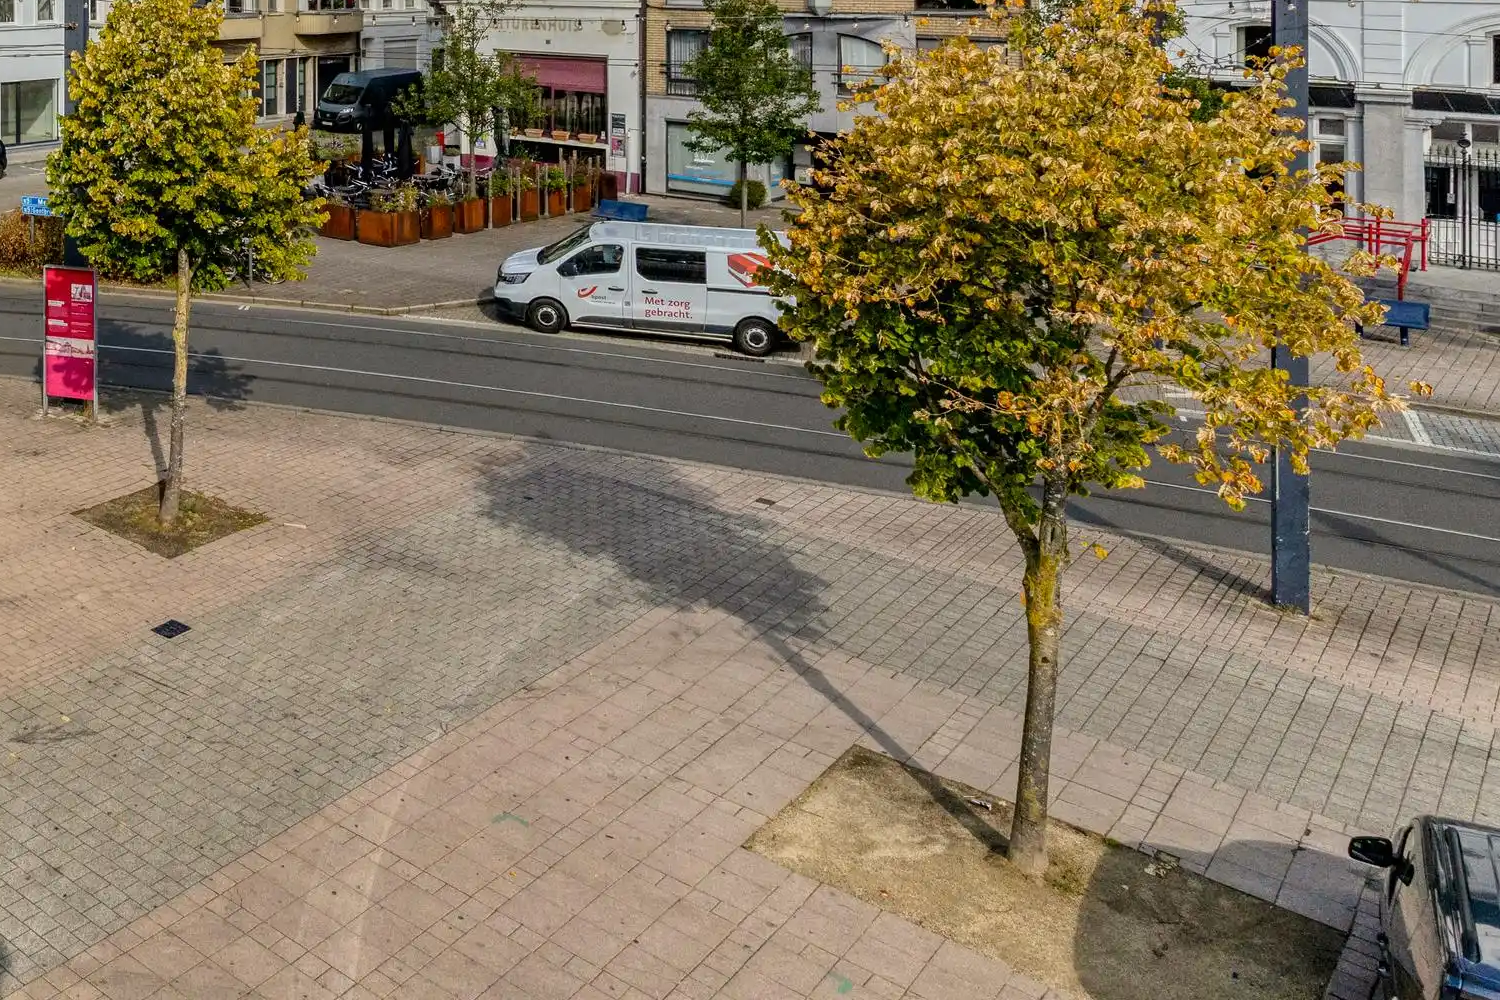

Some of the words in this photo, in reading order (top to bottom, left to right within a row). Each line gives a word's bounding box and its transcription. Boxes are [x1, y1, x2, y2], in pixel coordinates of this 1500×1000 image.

[644, 296, 665, 306] Met
[668, 300, 691, 311] zorg
[644, 308, 693, 320] gebracht.
